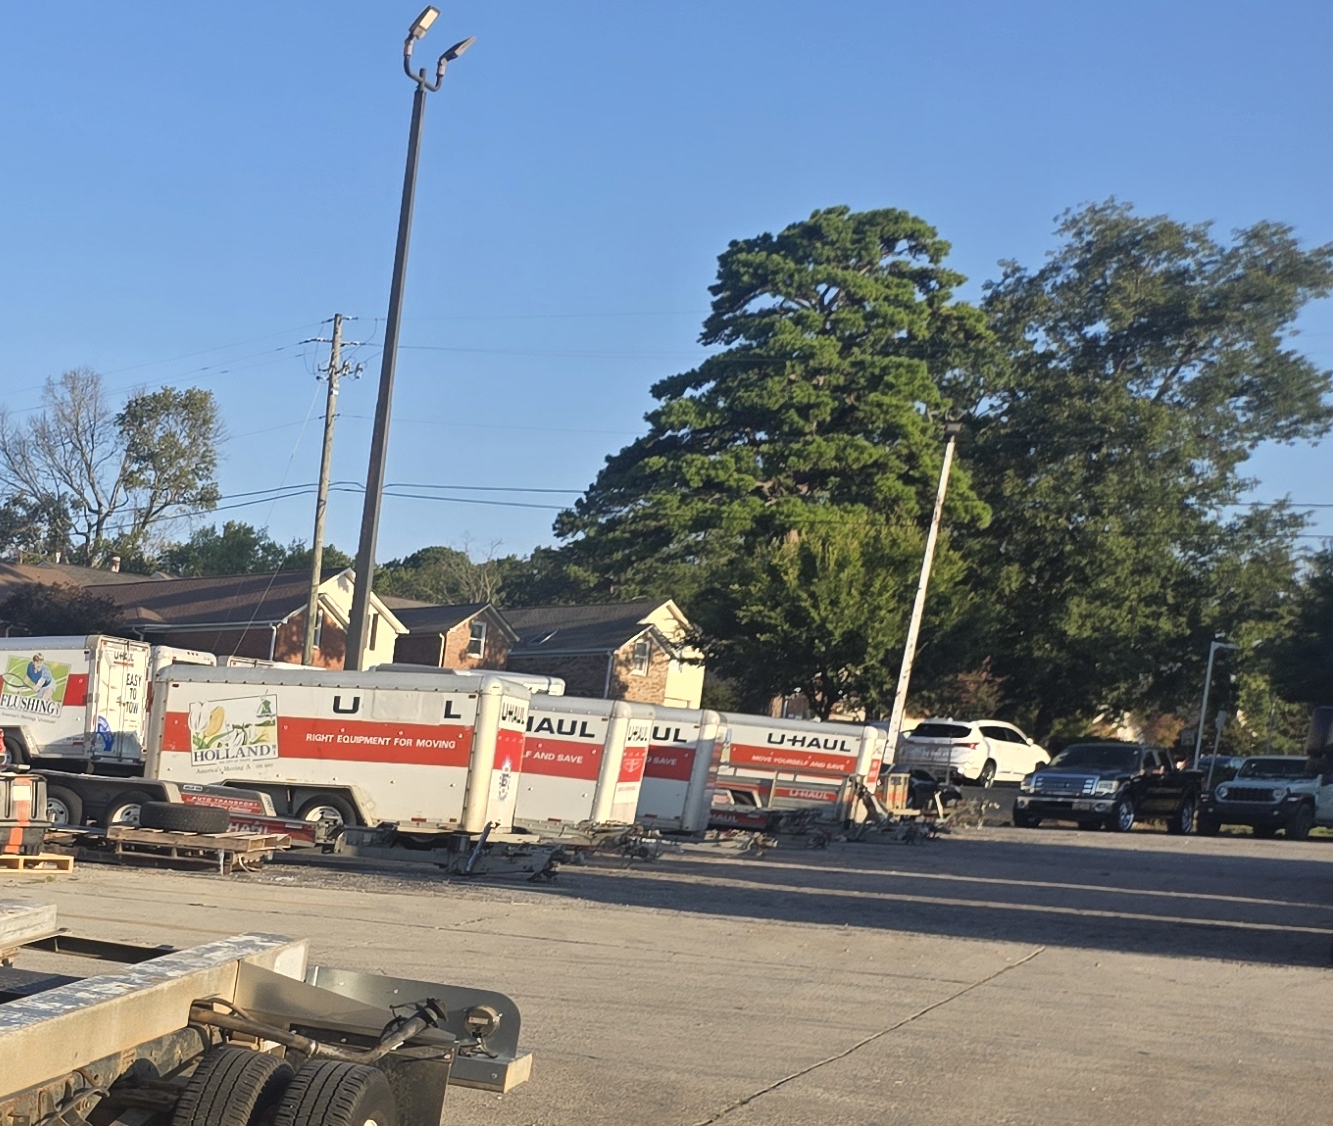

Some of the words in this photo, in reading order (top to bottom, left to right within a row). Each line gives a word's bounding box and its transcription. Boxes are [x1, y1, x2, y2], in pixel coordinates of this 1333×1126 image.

[126, 673, 142, 687] EASY
[129, 688, 137, 700] TO
[0, 694, 54, 715] FLUSHING
[125, 701, 139, 714] TOW
[306, 733, 334, 743] RIGHT
[336, 734, 391, 746] EQUIPMENT
[393, 737, 413, 747] FOR
[416, 739, 456, 749] MOVING
[767, 732, 852, 752] U-HAUL
[194, 744, 271, 762] HOLLAND
[533, 751, 555, 761] AND
[557, 753, 583, 764] SAVE
[653, 757, 677, 766] SAVE
